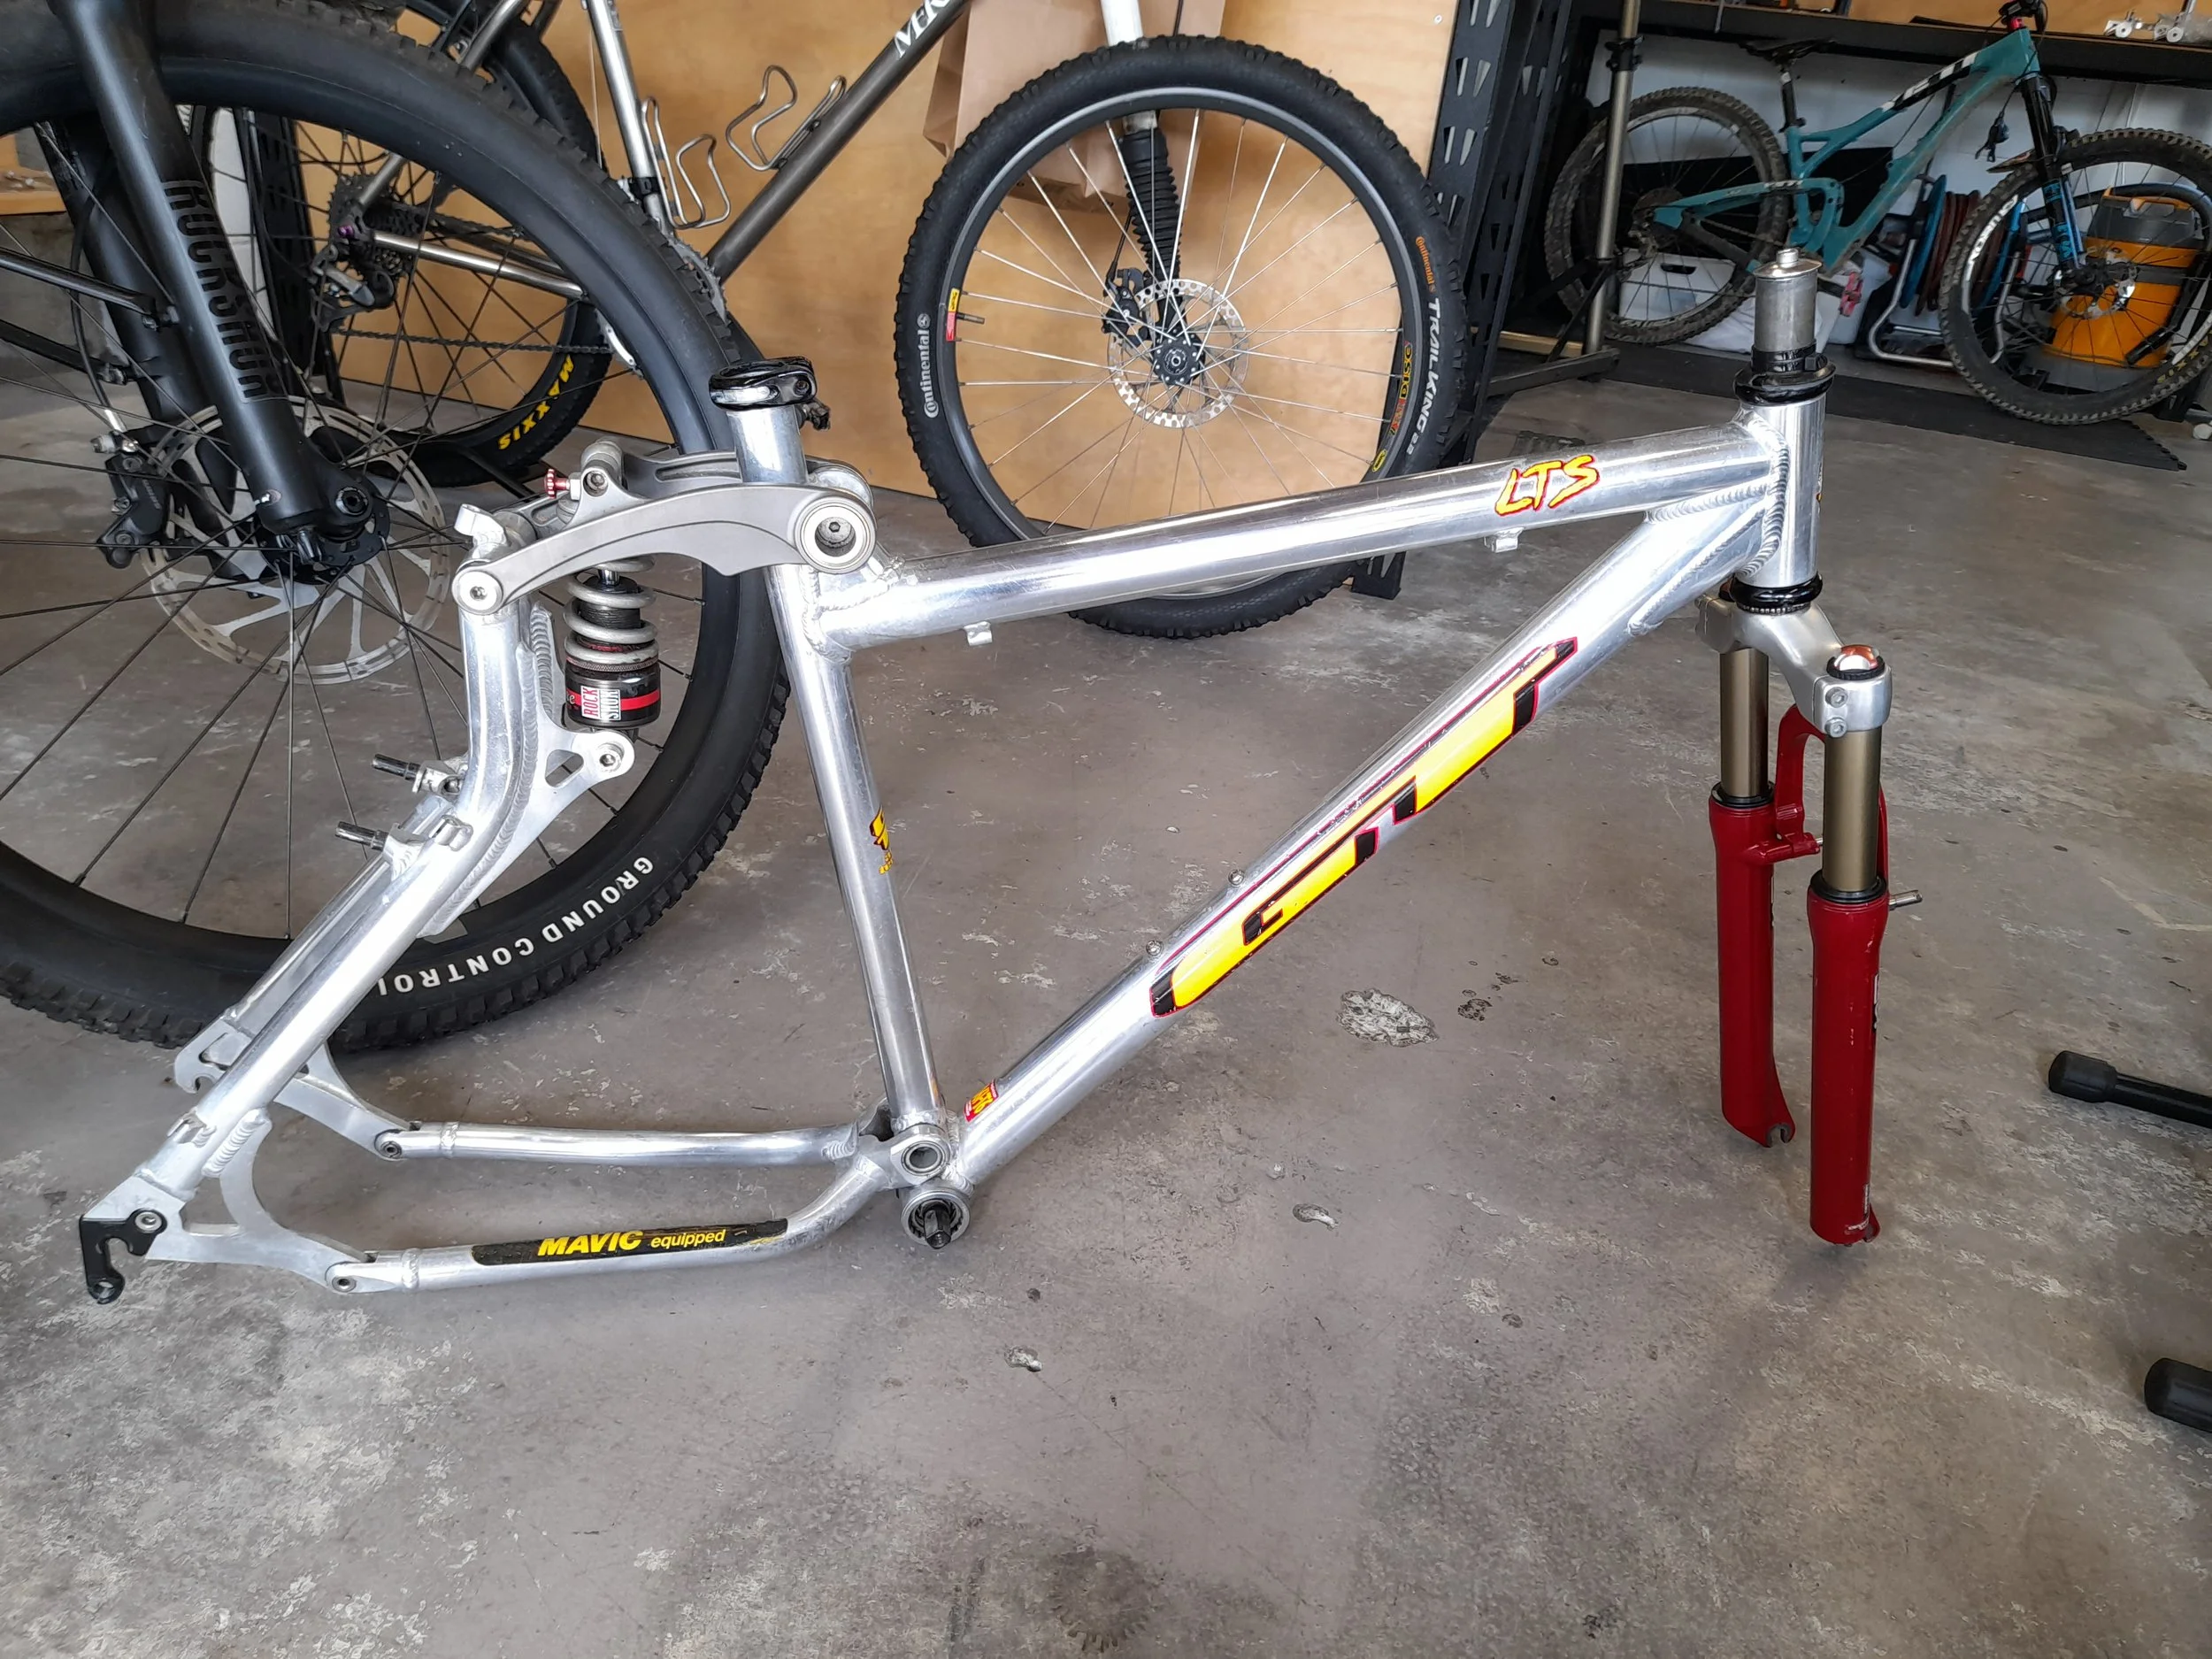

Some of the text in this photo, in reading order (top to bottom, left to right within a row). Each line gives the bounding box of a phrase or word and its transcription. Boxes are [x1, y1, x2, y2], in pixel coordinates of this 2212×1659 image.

[1428, 297, 1440, 370] TRAIL
[497, 354, 574, 450] MAXXIS
[917, 329, 939, 419] Continental
[1399, 343, 1413, 399] DISC
[1416, 371, 1440, 434] KING
[1494, 454, 1600, 517] LTS
[583, 687, 599, 718] ROCK
[541, 856, 654, 943] GROUND
[537, 1229, 726, 1256] MAVIC equipped
